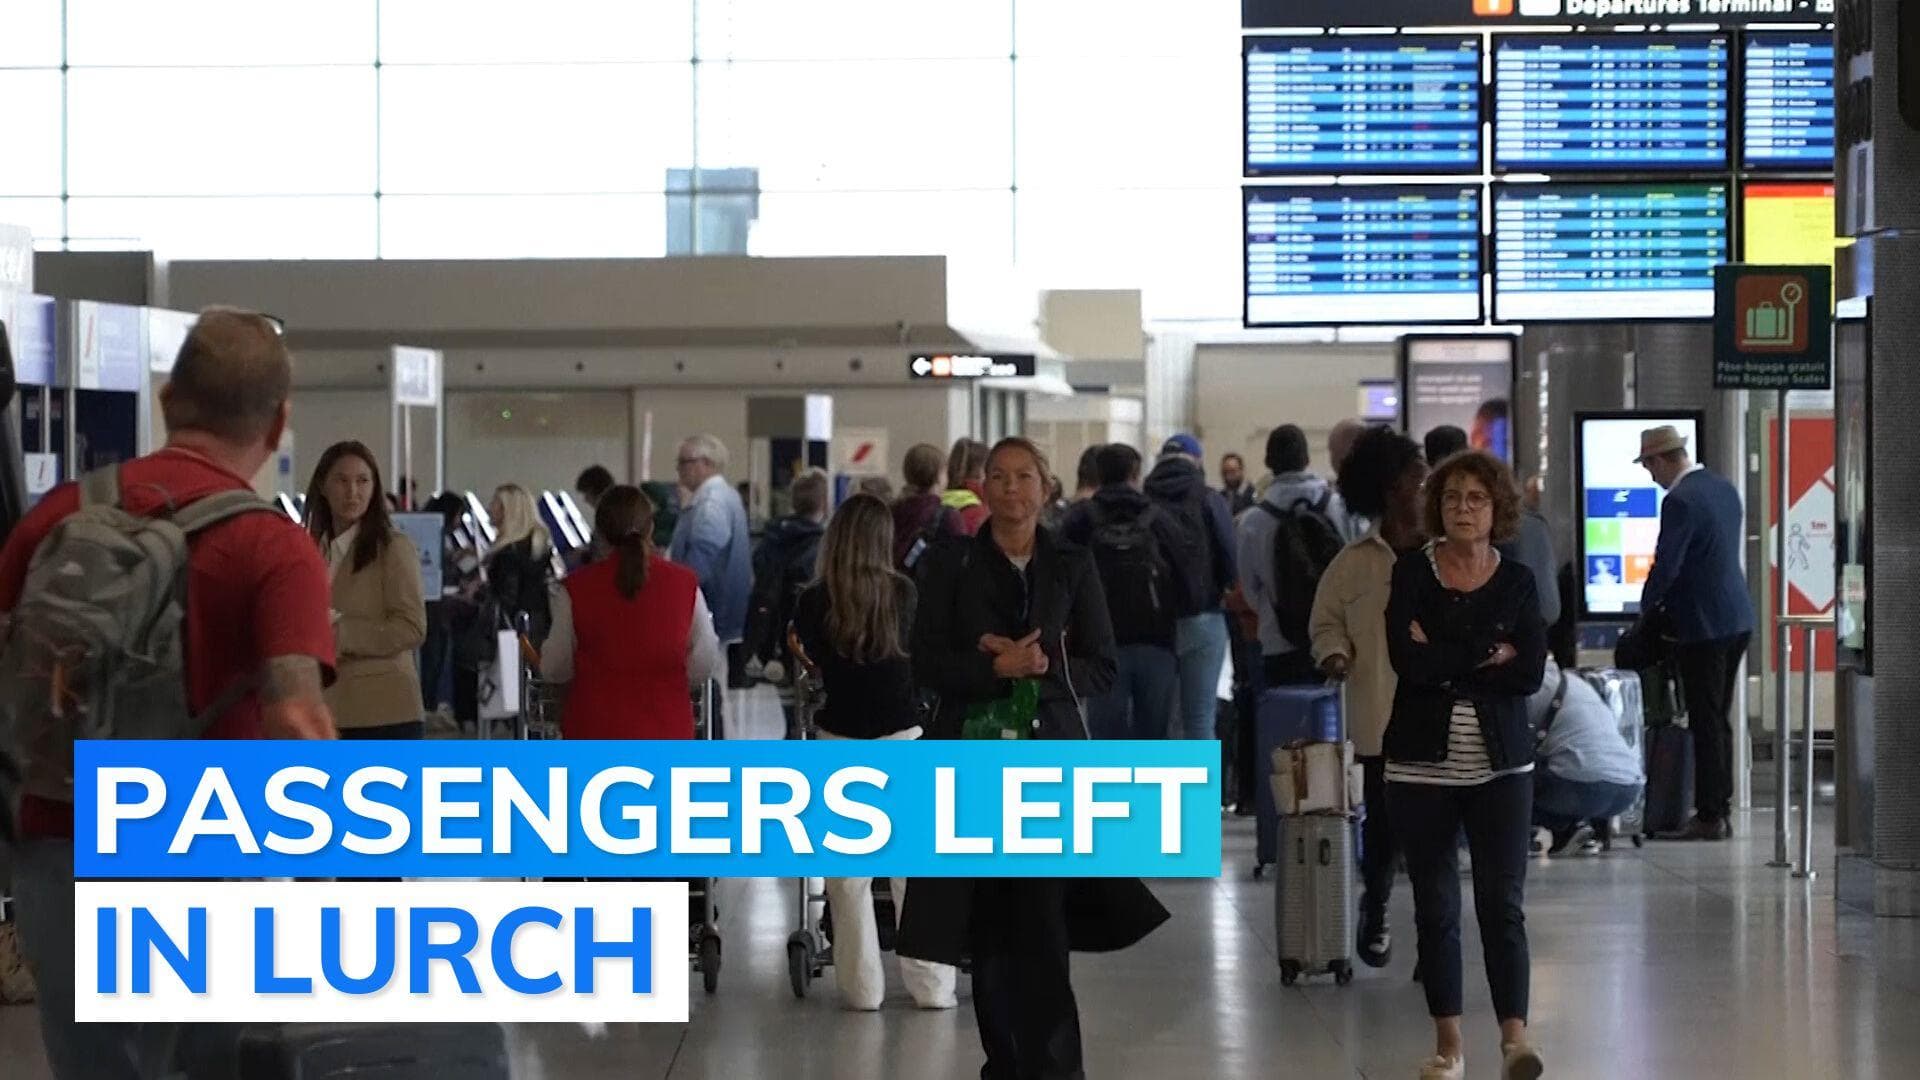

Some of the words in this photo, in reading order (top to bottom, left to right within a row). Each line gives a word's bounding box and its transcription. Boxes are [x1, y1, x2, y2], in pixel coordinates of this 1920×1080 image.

[1566, 0, 1690, 17] Departures
[1698, 0, 1793, 13] Terminal
[1717, 373, 1741, 383] Free
[1743, 373, 1789, 386] Baggage
[1792, 373, 1826, 384] Scales
